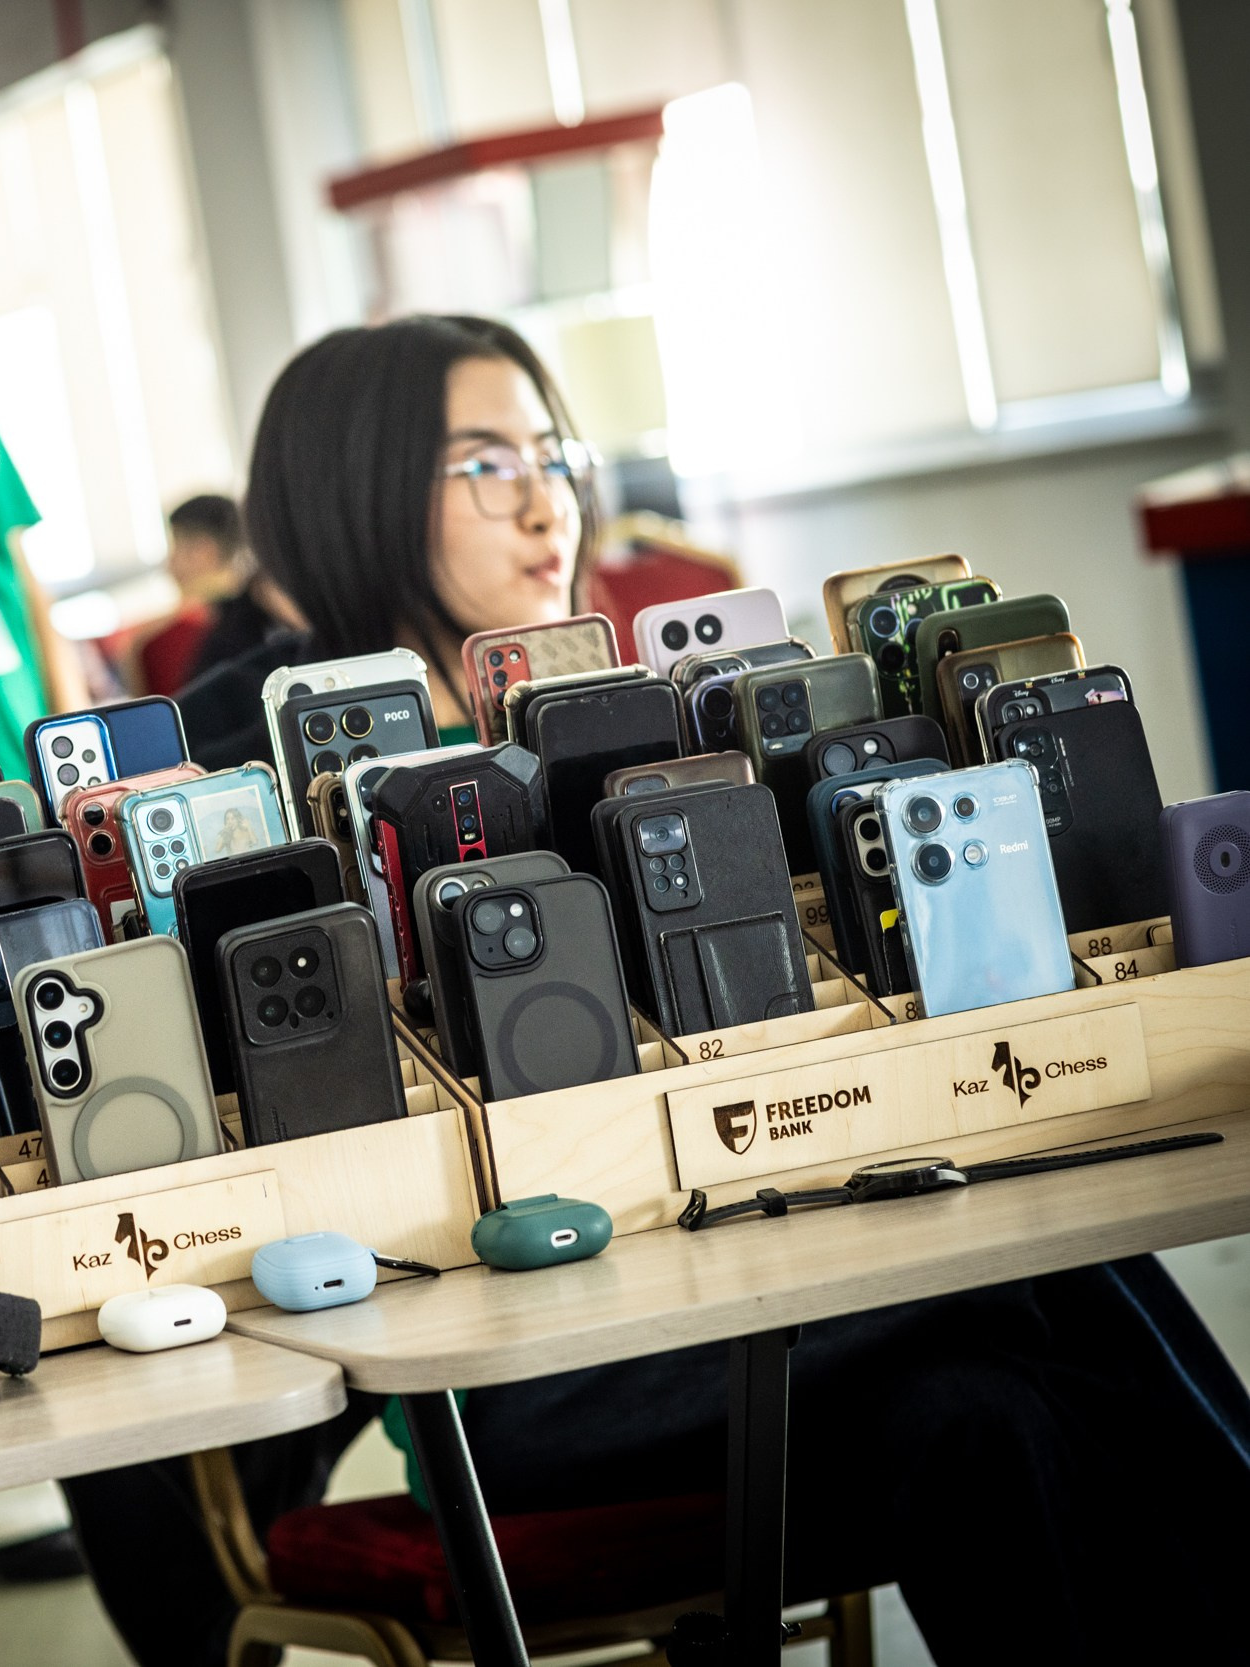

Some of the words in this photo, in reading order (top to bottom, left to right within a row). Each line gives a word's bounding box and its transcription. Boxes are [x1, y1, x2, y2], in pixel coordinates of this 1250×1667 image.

[384, 709, 410, 723] POCO
[999, 840, 1029, 855] Redmi
[805, 904, 830, 926] 99
[1088, 937, 1113, 957] 88
[1114, 959, 1139, 981] 84
[904, 1001, 918, 1020] 8
[699, 1038, 725, 1060] 82
[953, 1079, 990, 1098] Kaz
[1045, 1056, 1108, 1079] Chess
[766, 1085, 872, 1123] FREEDOM
[768, 1119, 813, 1141] BANK
[18, 1137, 43, 1159] 47
[36, 1168, 50, 1187] 4
[72, 1252, 113, 1272] Kaz
[173, 1225, 242, 1251] Chess
